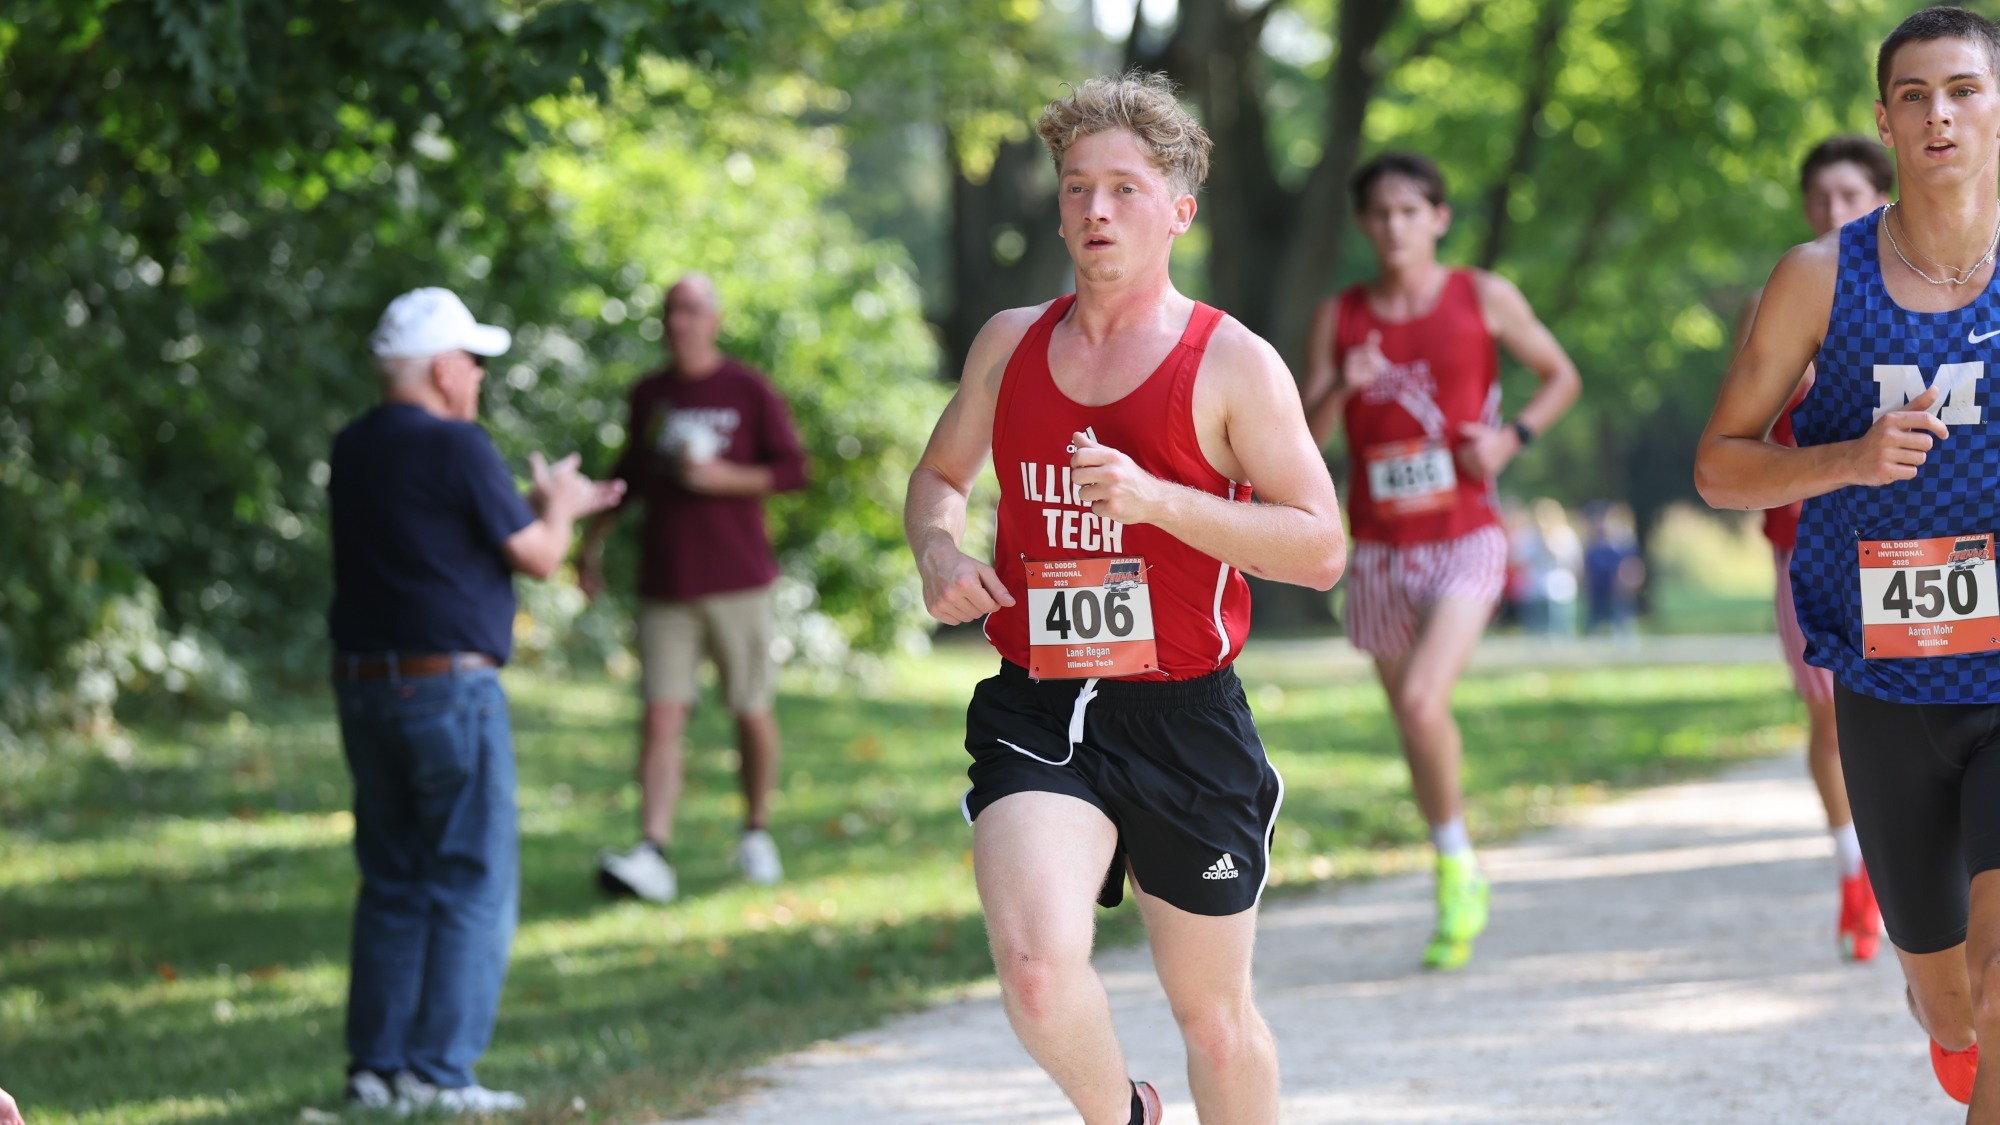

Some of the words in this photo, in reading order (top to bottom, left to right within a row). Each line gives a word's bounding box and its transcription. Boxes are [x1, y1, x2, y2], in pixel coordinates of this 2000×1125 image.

[1872, 361, 1984, 425] M
[1020, 462, 1093, 507] ILLI
[1042, 508, 1123, 553] TECH
[1894, 541, 1919, 549] DODDS
[1878, 550, 1925, 558] INVITATIONAL
[1041, 570, 1082, 578] INVITATIONAL
[1882, 567, 1979, 619] 450
[1045, 589, 1134, 640] 406
[1908, 626, 1931, 637] Aaron
[1933, 624, 1954, 635] Mohr
[1917, 639, 1949, 647] Millikin
[1066, 647, 1084, 657] Lane
[1086, 646, 1111, 658] Regan
[1067, 660, 1094, 669] Illinois
[1095, 659, 1114, 667] Tech
[1202, 869, 1239, 880] adidas
